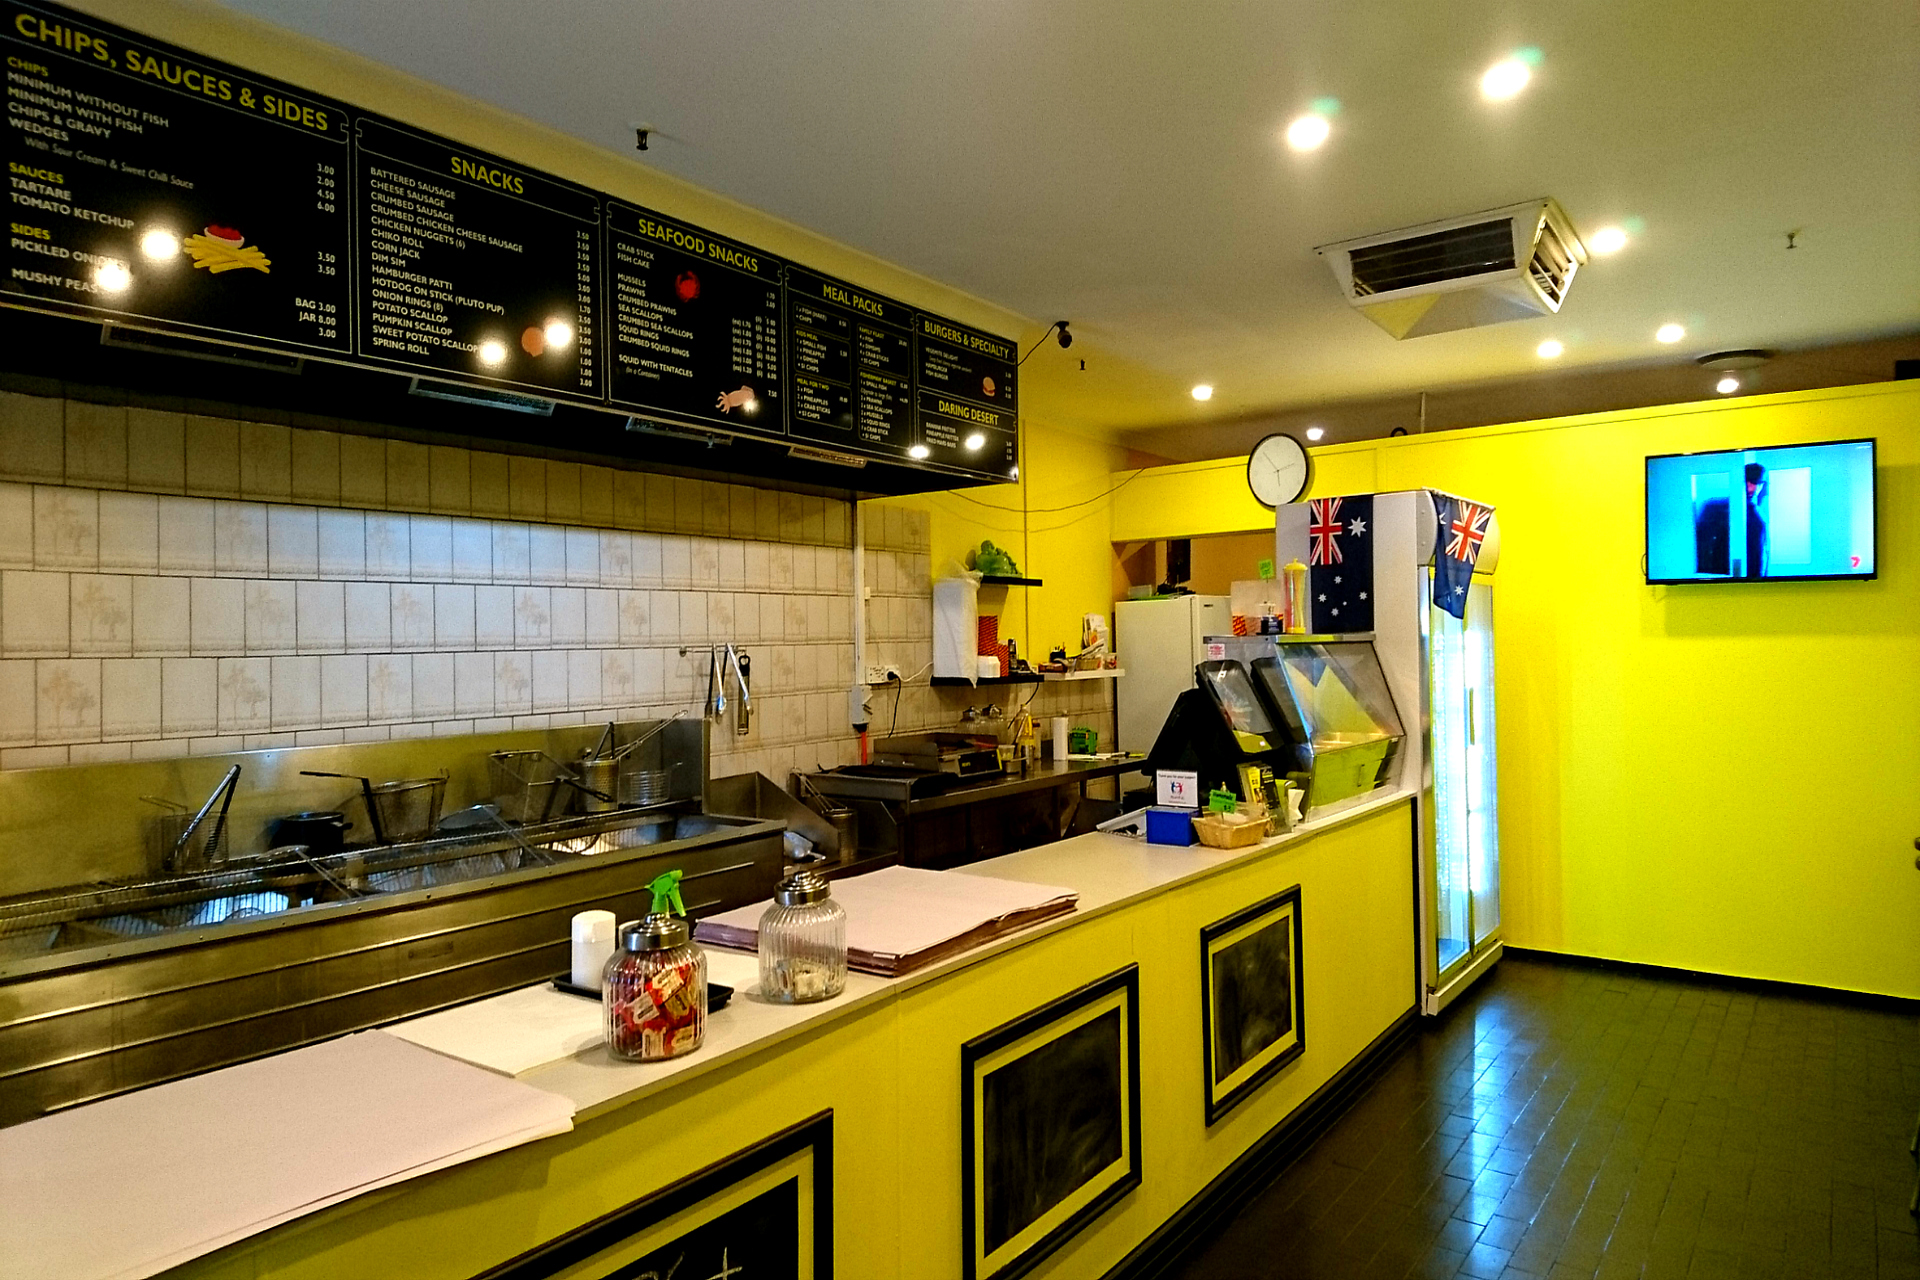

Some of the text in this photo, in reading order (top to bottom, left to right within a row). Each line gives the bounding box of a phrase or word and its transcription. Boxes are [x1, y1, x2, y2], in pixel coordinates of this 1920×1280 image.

[7, 56, 48, 77] CHIPS
[15, 14, 328, 130] CHIPS, SAUCES & SIDES
[7, 71, 169, 128] MINIMUM WITHOUT FISH
[8, 86, 143, 134] MINIMUM WITH FISH
[8, 102, 111, 139] CHIPS & GRAVY
[8, 116, 69, 142] WEDGES
[24, 136, 49, 150] With
[76, 150, 107, 167] Cream
[109, 159, 118, 170] &
[122, 162, 146, 177] Sweet
[148, 169, 168, 182] Chilli
[317, 163, 334, 175] 3.00
[9, 162, 64, 184] SAUCES
[317, 176, 335, 188] 2.00
[370, 166, 456, 200] BATTERED SAUSAGE
[451, 156, 524, 194] SNACKS
[10, 176, 72, 201] TARTARE
[317, 189, 335, 200] 4.50
[371, 179, 445, 208] CHEESE SAUSAGE
[10, 192, 135, 229] TOMATO KETCHUP
[317, 201, 335, 213] 6.00
[371, 191, 454, 222] CRUMBED SAUSAGE
[10, 222, 50, 240] SIDES
[371, 204, 523, 253] CRUMBED CHICKEN CHEESE SAUSAGE
[371, 216, 411, 233] CHICKEN
[413, 227, 454, 245] NUGGETS
[372, 228, 424, 249] CHIKO ROLL
[11, 238, 69, 258] PICKLED
[372, 240, 420, 260] CORN JACK
[617, 242, 654, 260] CRAB STICK
[638, 218, 758, 272] SEAFOOD SNACKS
[318, 251, 335, 263] 3.50
[372, 252, 406, 267] DIM SIM
[617, 252, 650, 269] FISH CAKE
[11, 268, 99, 294] MUSHY PEAS
[318, 264, 335, 276] 3.50
[372, 264, 452, 290] HAMBURGER PATTI
[618, 273, 646, 287] MUSSELS
[372, 276, 505, 316] HOTDOG ON STICK (PLUTO PUP)
[372, 289, 403, 303] ONION
[406, 295, 432, 309] RINGS
[618, 283, 646, 297] PRAWNS
[823, 284, 883, 316] MEAL PACKS
[296, 297, 336, 313] BAG 3.00
[372, 301, 448, 324] POTATO SCALLOP
[618, 294, 677, 316] CRUMBED PRAWNS
[618, 303, 663, 322] SEA SCALLOPS
[299, 311, 336, 326] JAR 8.00
[373, 313, 453, 336] PUMPKIN SCALLOP
[618, 314, 693, 339] CRUMBED SEA SCALLOPS
[319, 327, 336, 338] 3.00
[373, 325, 479, 353] SWEET POTATO SCALLOP
[618, 324, 659, 340] SQUID RINGS
[924, 321, 1010, 359] BURGERS & SPECIALTY
[373, 337, 430, 356] SPRING ROLL
[618, 334, 690, 358] CRUMBED SQUID RINGS
[619, 354, 693, 378] SQUID WITH TENTACLES
[939, 400, 999, 426] DARING DESERT
